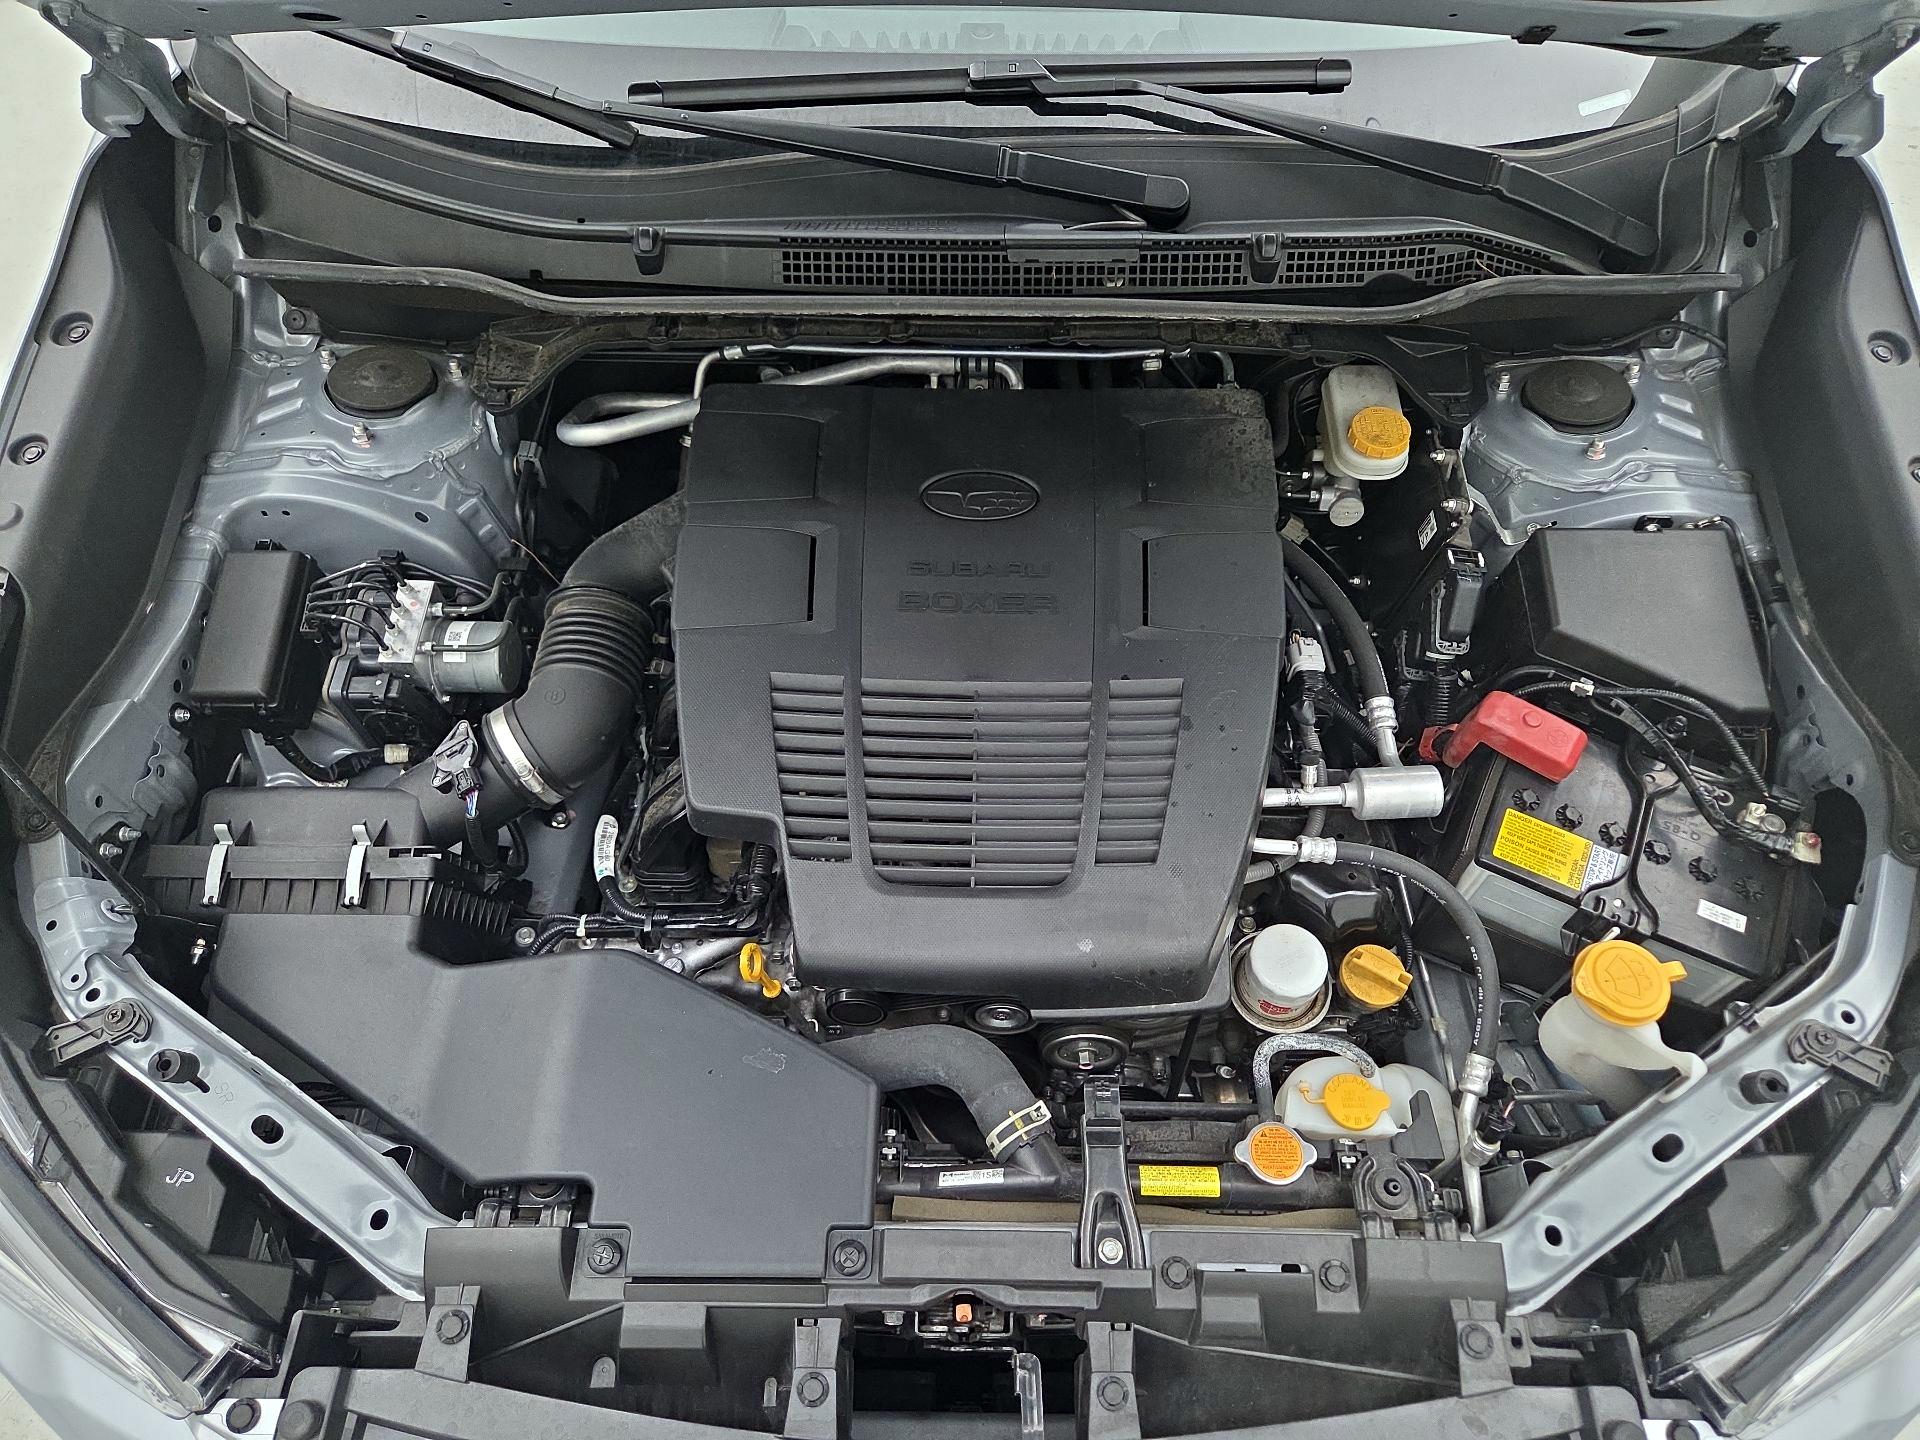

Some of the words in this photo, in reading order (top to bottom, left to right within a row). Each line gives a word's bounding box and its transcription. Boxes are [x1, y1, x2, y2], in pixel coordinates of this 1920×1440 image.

[906, 560, 1051, 578] SUBARU
[897, 591, 1057, 614] BOXER
[1507, 810, 1533, 824] DANGER
[1499, 835, 1524, 848] POISON
[1478, 986, 1483, 999] HP
[165, 1167, 195, 1187] JP
